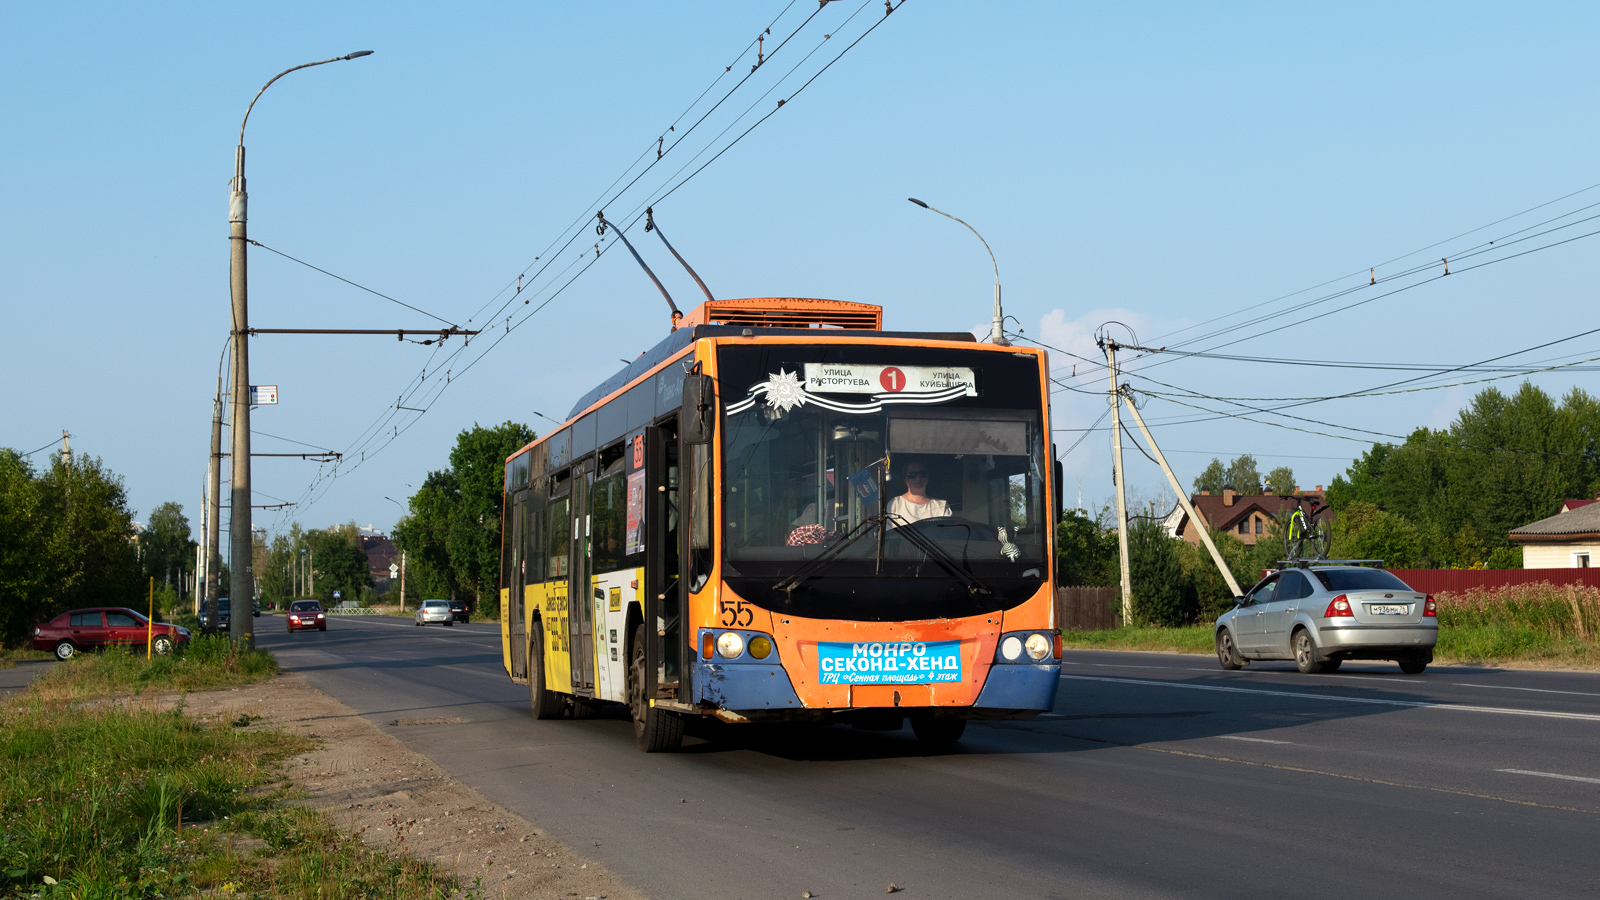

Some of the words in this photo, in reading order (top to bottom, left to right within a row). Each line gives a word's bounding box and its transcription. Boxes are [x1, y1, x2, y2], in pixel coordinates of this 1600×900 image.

[824, 369, 853, 377] УЛИЦА
[933, 372, 961, 380] УЛИЦА
[811, 377, 870, 386] РАСТОРГУЕВА
[887, 371, 897, 390] 1
[720, 601, 754, 627] 55
[852, 643, 927, 657] МОНРО
[821, 656, 959, 672] СЕКОНД-ХЕНД
[822, 672, 840, 685] ТРЦ
[928, 671, 935, 681] 4
[936, 673, 958, 681] этаж
